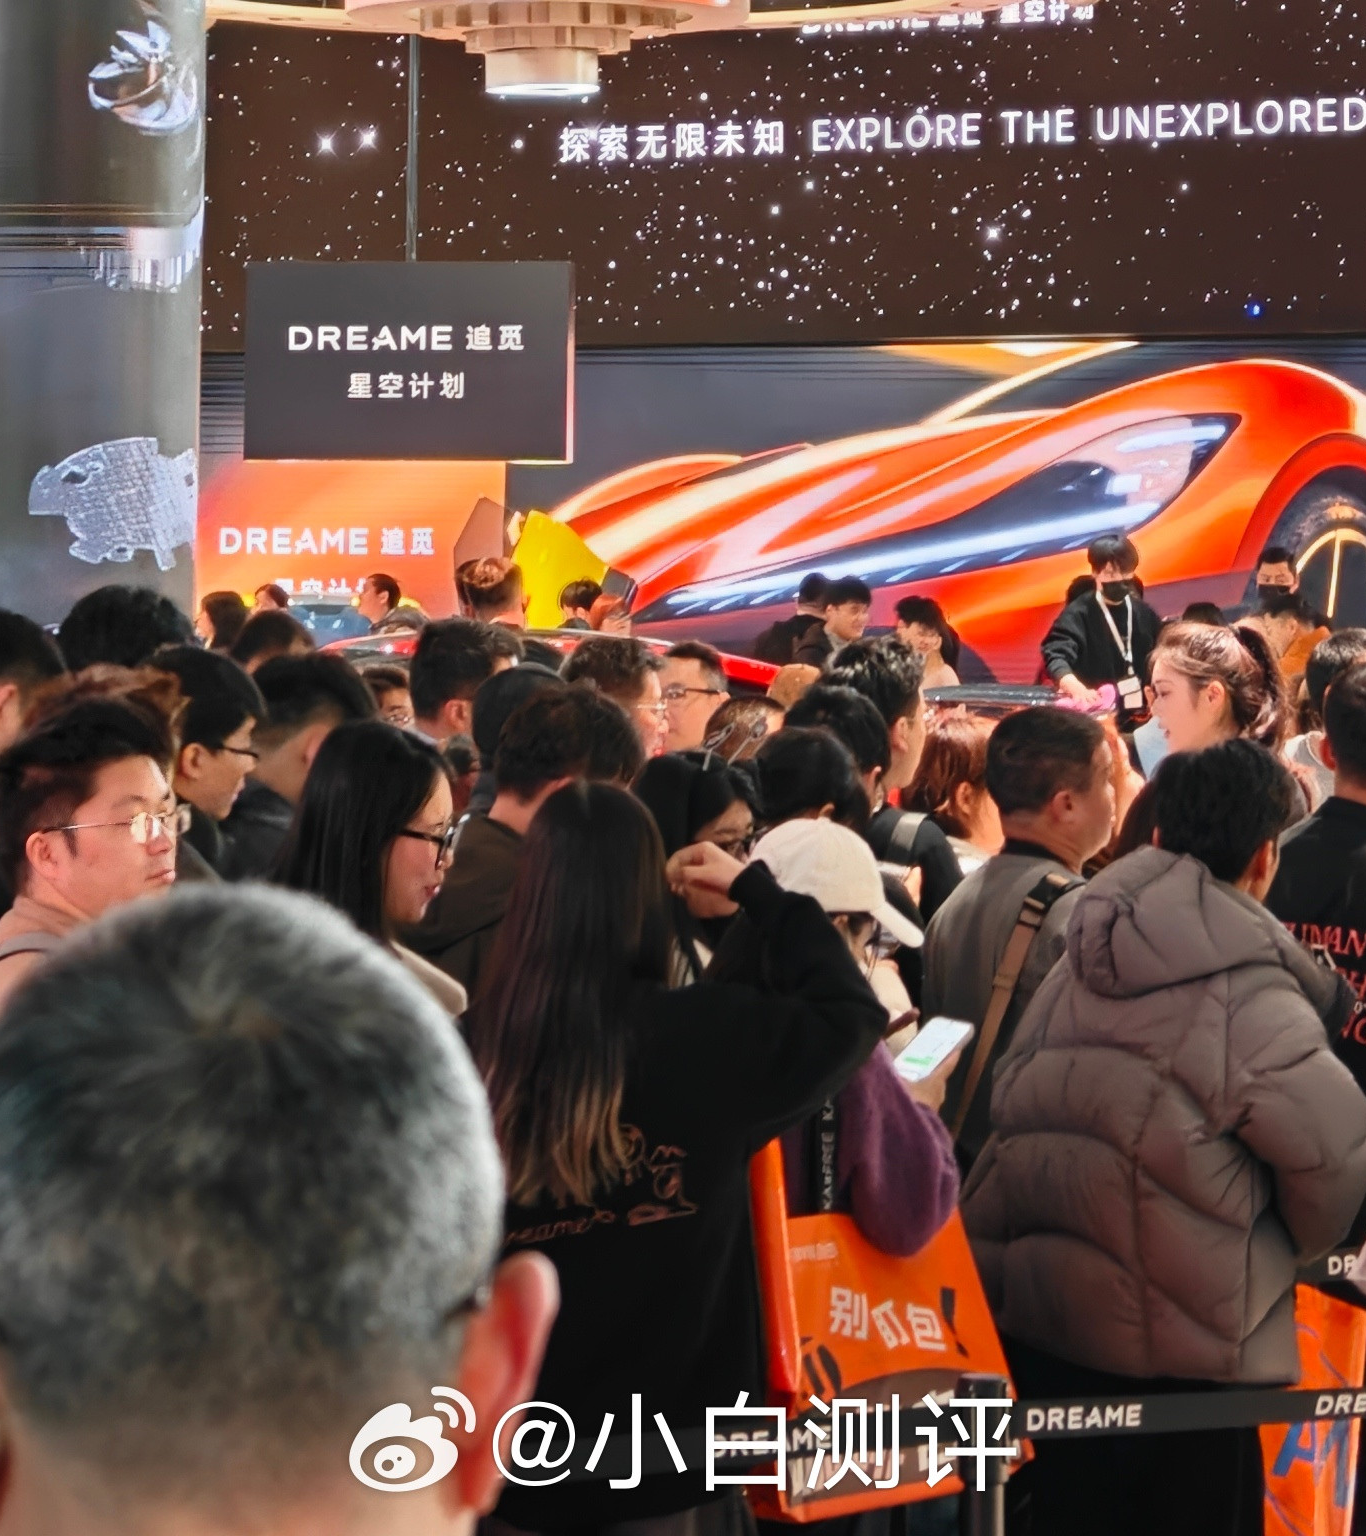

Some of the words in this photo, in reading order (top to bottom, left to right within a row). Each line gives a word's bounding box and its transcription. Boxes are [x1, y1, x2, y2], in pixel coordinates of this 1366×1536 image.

[559, 119, 785, 162] 探索无限未知
[811, 113, 982, 152] EXPLORE
[1001, 108, 1075, 144] THE
[287, 325, 453, 351] DREAME
[465, 323, 525, 351] 追觅
[347, 371, 465, 399] 星空计划
[219, 528, 369, 555] DREAME
[381, 526, 434, 556] 追觅
[1026, 1403, 1144, 1431] DREAME
